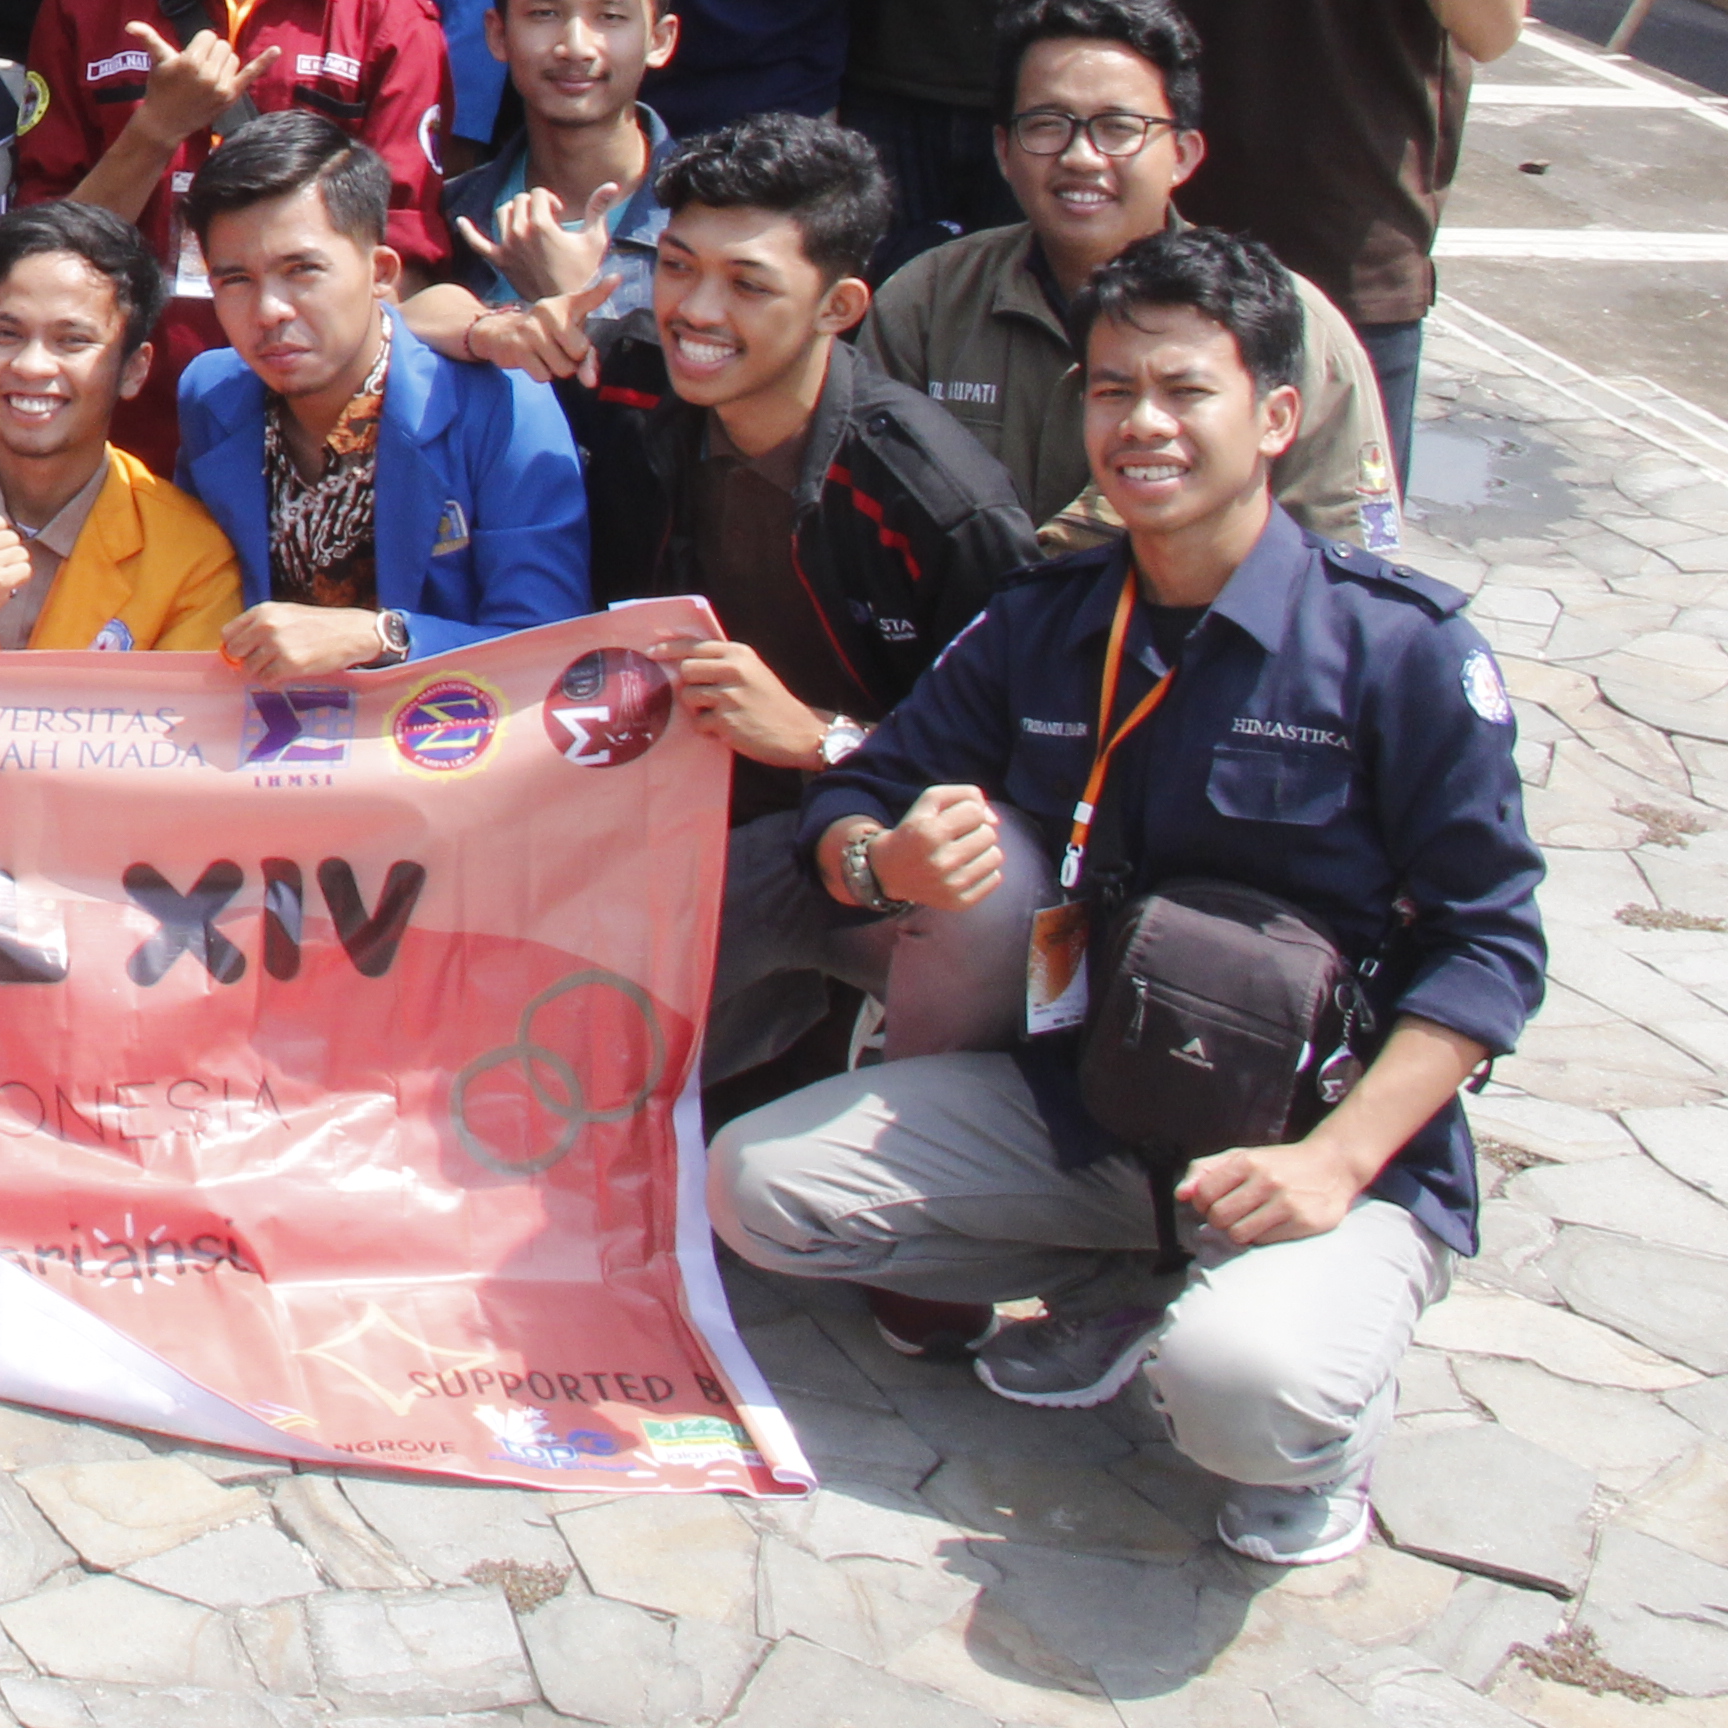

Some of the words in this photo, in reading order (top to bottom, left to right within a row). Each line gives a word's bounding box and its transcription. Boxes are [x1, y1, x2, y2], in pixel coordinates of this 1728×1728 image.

[1231, 717, 1352, 751] HIMASTIKA
[77, 739, 206, 771] MADA
[253, 773, 335, 790] IHMSI
[121, 854, 428, 988] XIV
[406, 1370, 676, 1405] SUPPORTED
